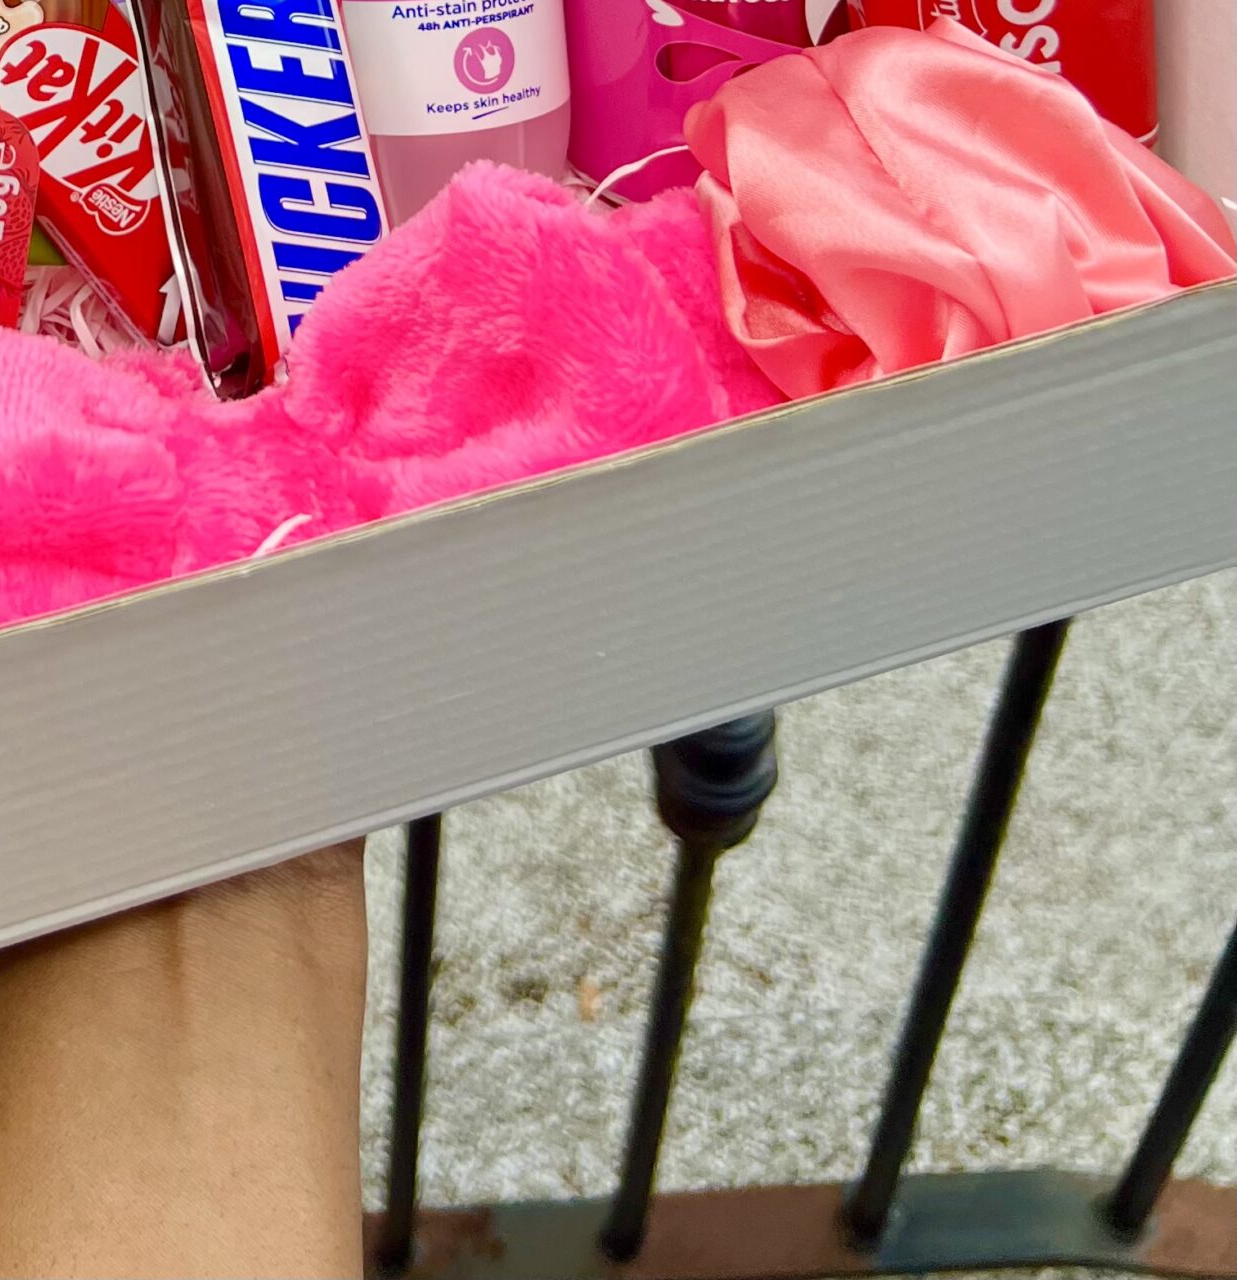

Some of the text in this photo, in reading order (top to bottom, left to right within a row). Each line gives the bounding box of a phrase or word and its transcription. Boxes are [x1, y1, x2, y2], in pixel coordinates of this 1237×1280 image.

[392, 0, 477, 20] Anti-stain
[417, 4, 534, 32] 48h ANTI-PERSPIRANT
[0, 37, 153, 192] KitKat
[426, 85, 541, 115] Keeps skin healthy
